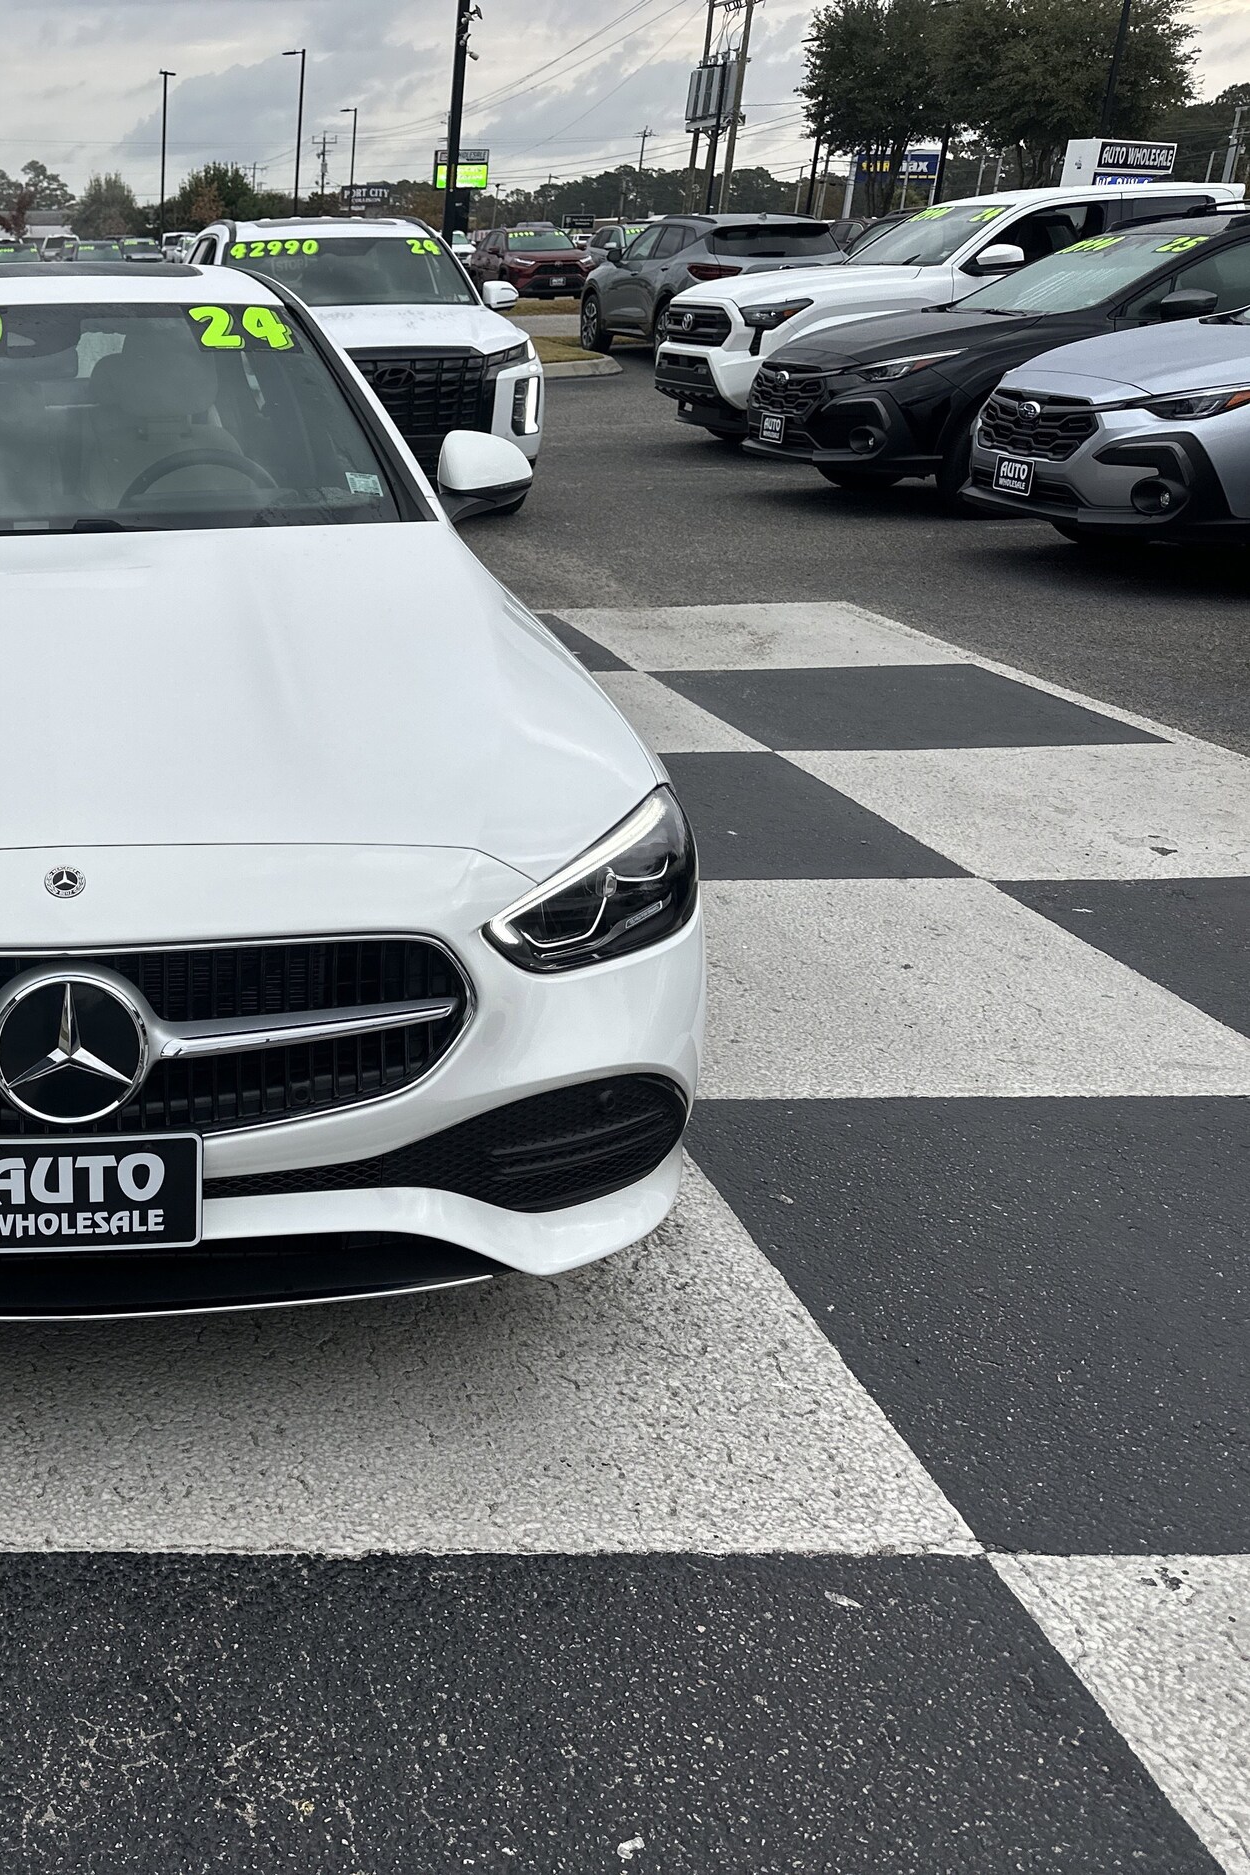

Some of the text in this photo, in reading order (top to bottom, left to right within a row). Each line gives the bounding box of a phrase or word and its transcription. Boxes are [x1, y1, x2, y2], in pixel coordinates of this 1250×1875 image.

[1101, 146, 1173, 167] AUTO WHOLESALE
[369, 188, 390, 198] CITY
[230, 239, 442, 260] 42990 24
[1154, 236, 1210, 253] 25
[188, 305, 295, 351] 24
[764, 417, 781, 431] AUTO
[1000, 460, 1028, 480] AUTO
